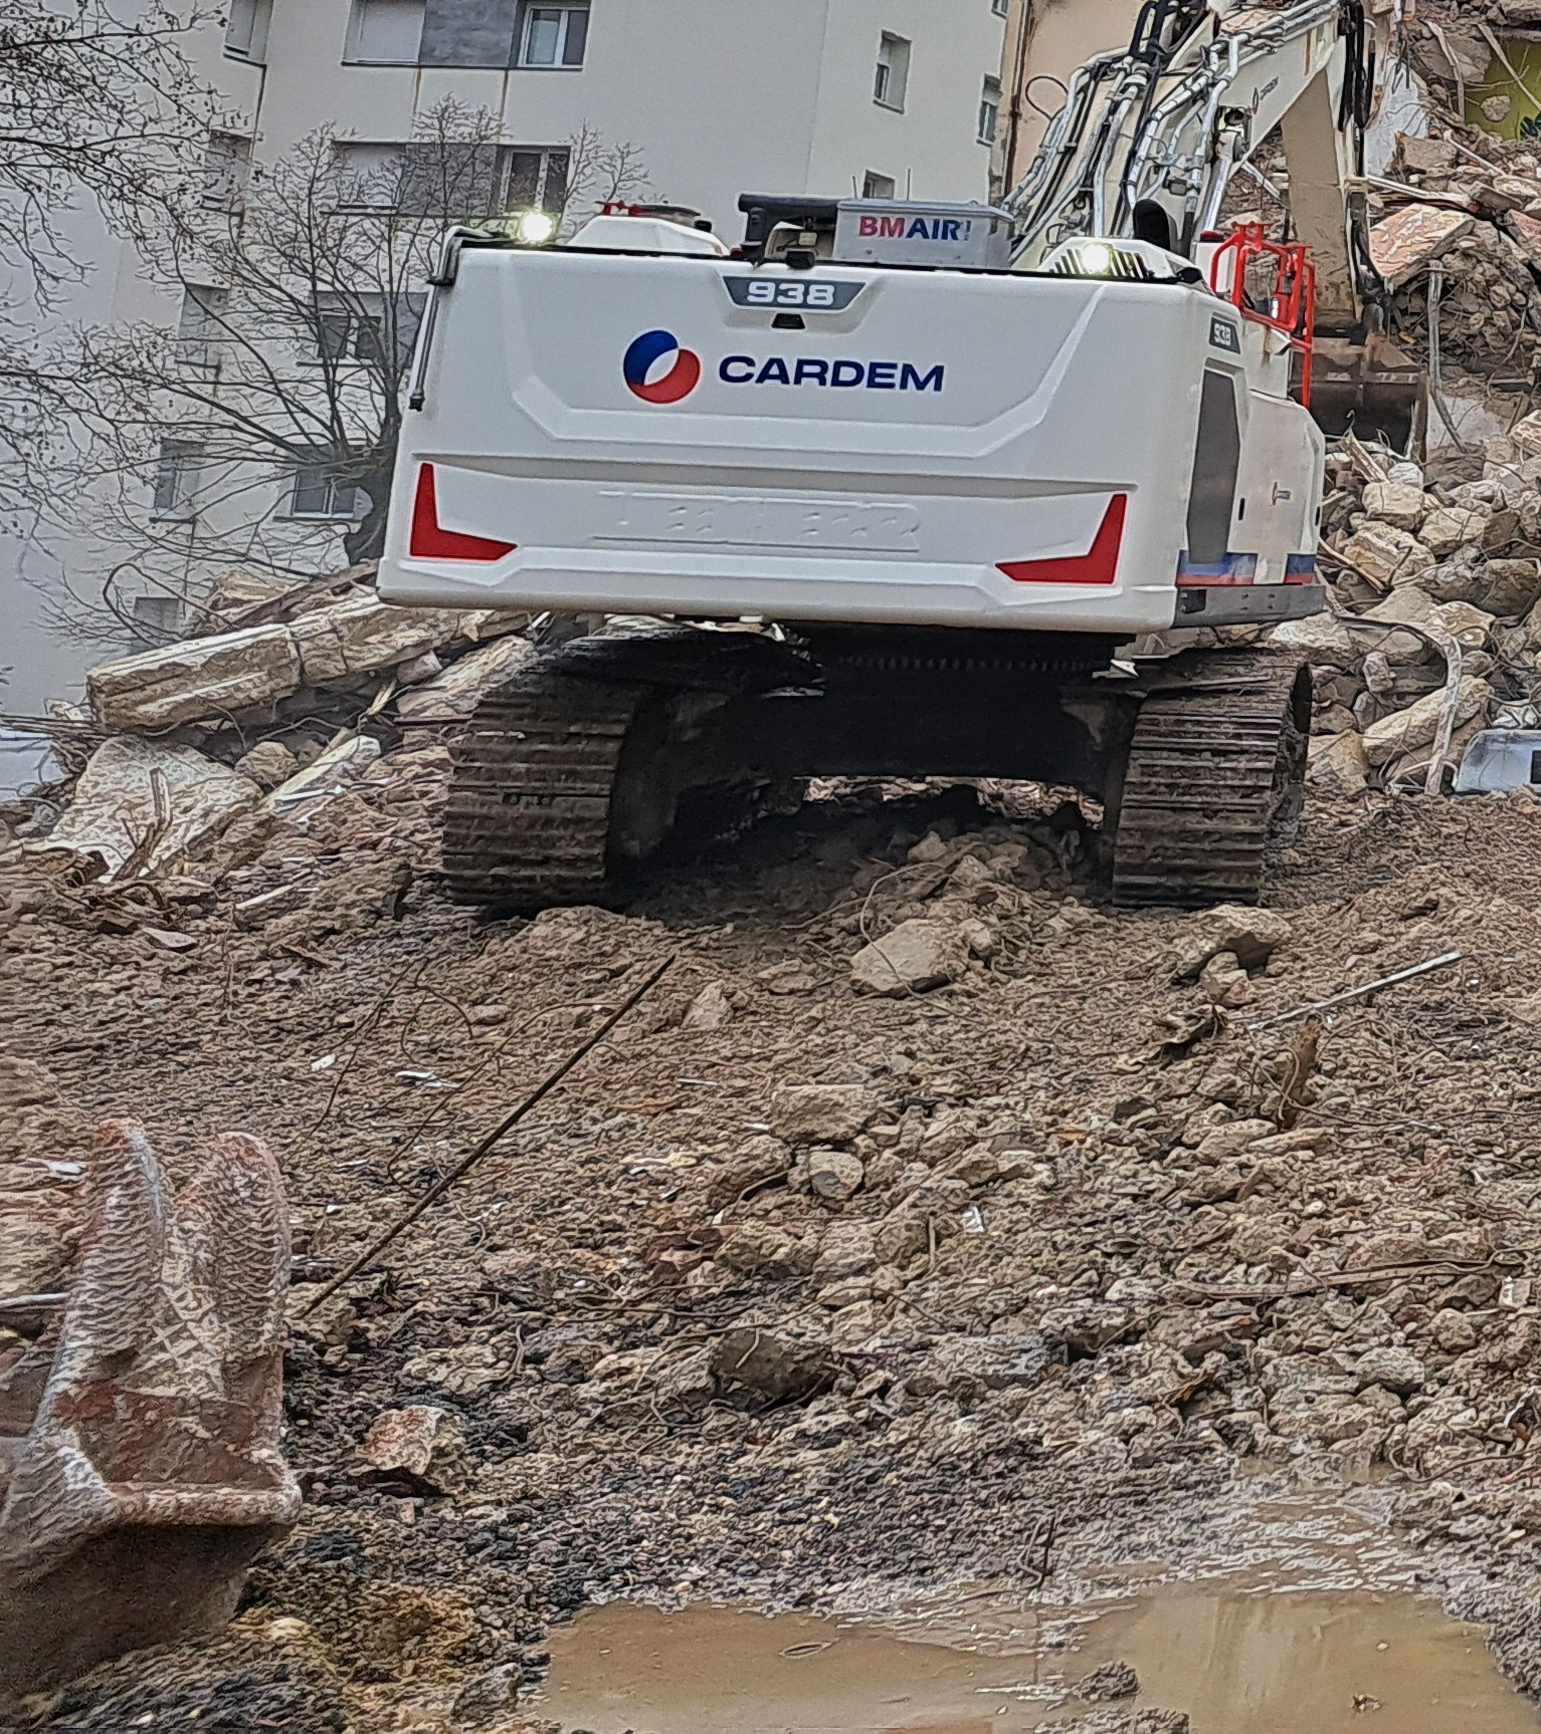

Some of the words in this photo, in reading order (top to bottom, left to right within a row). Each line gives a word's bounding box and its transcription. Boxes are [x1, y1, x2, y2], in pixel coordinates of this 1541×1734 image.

[858, 215, 961, 241] BMAIR
[746, 281, 836, 306] 938
[719, 355, 945, 392] CARDEM
